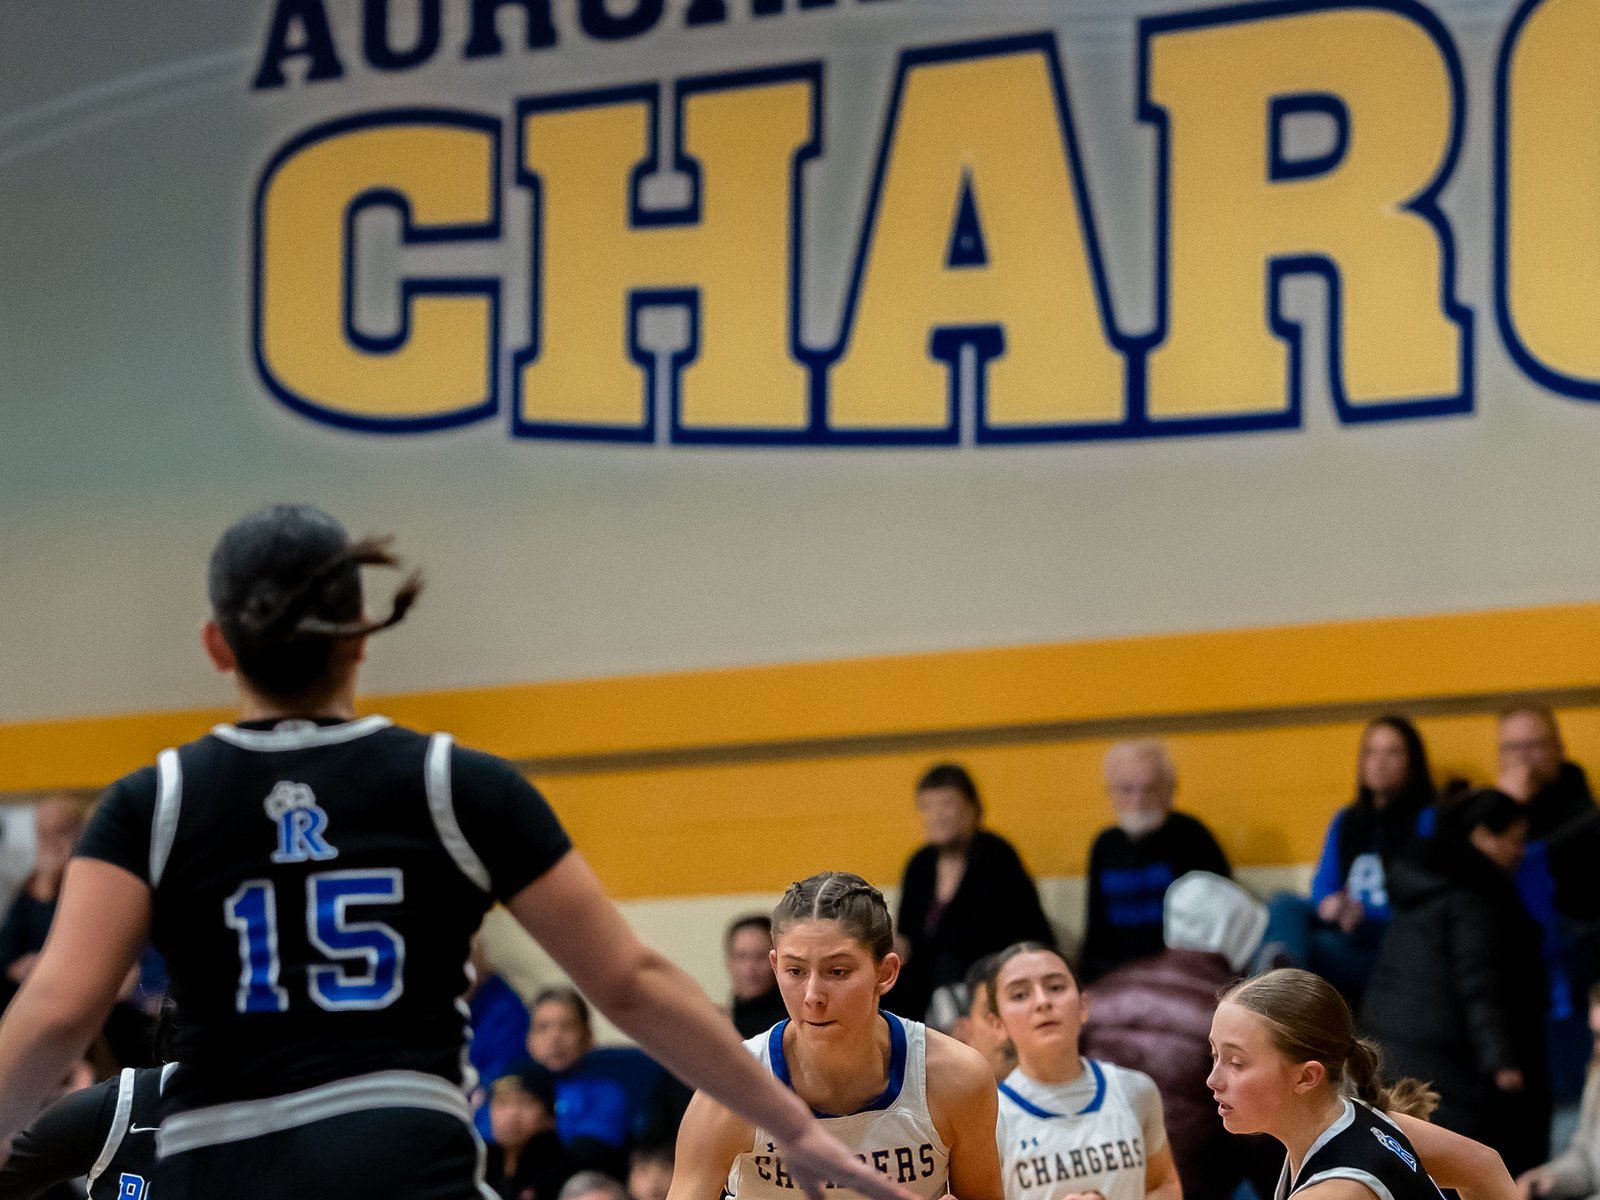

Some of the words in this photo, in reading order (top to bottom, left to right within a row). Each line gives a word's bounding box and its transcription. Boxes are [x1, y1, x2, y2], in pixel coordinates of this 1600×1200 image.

[269, 804, 340, 864] R
[223, 866, 406, 1014] 15
[754, 1142, 936, 1190] CHERS
[1015, 1137, 1144, 1190] CHARGERS
